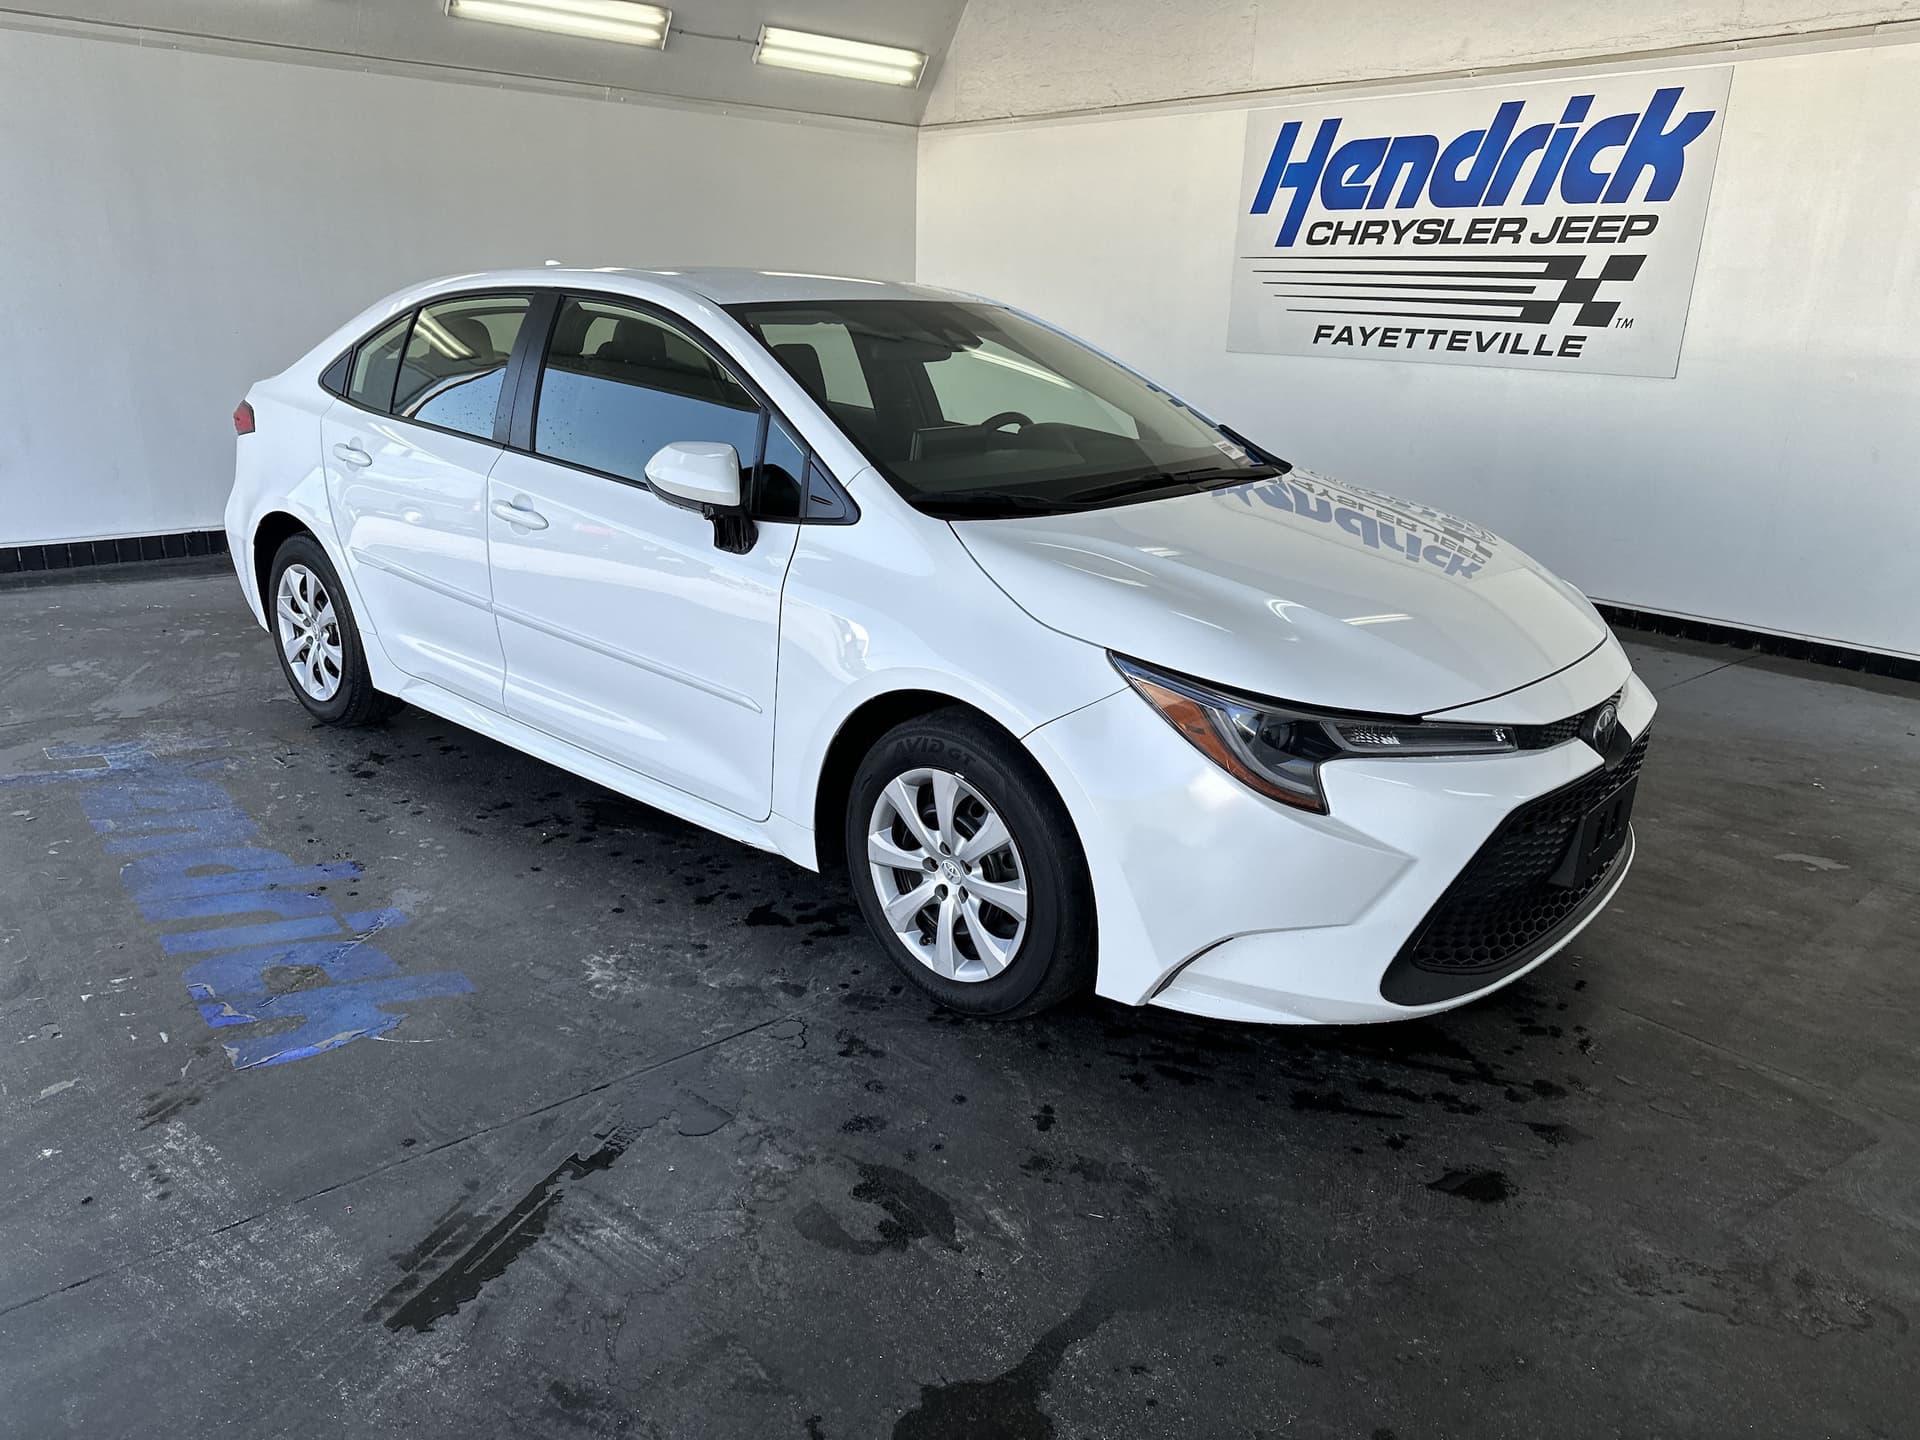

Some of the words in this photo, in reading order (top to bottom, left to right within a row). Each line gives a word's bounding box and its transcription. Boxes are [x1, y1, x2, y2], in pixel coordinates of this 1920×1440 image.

[1250, 87, 1716, 247] Hendrick
[1306, 214, 1528, 246] CHRYSLER
[1530, 214, 1659, 244] JEEP
[1614, 318, 1634, 329] TM
[1312, 325, 1587, 358] FAYETTEVILLE
